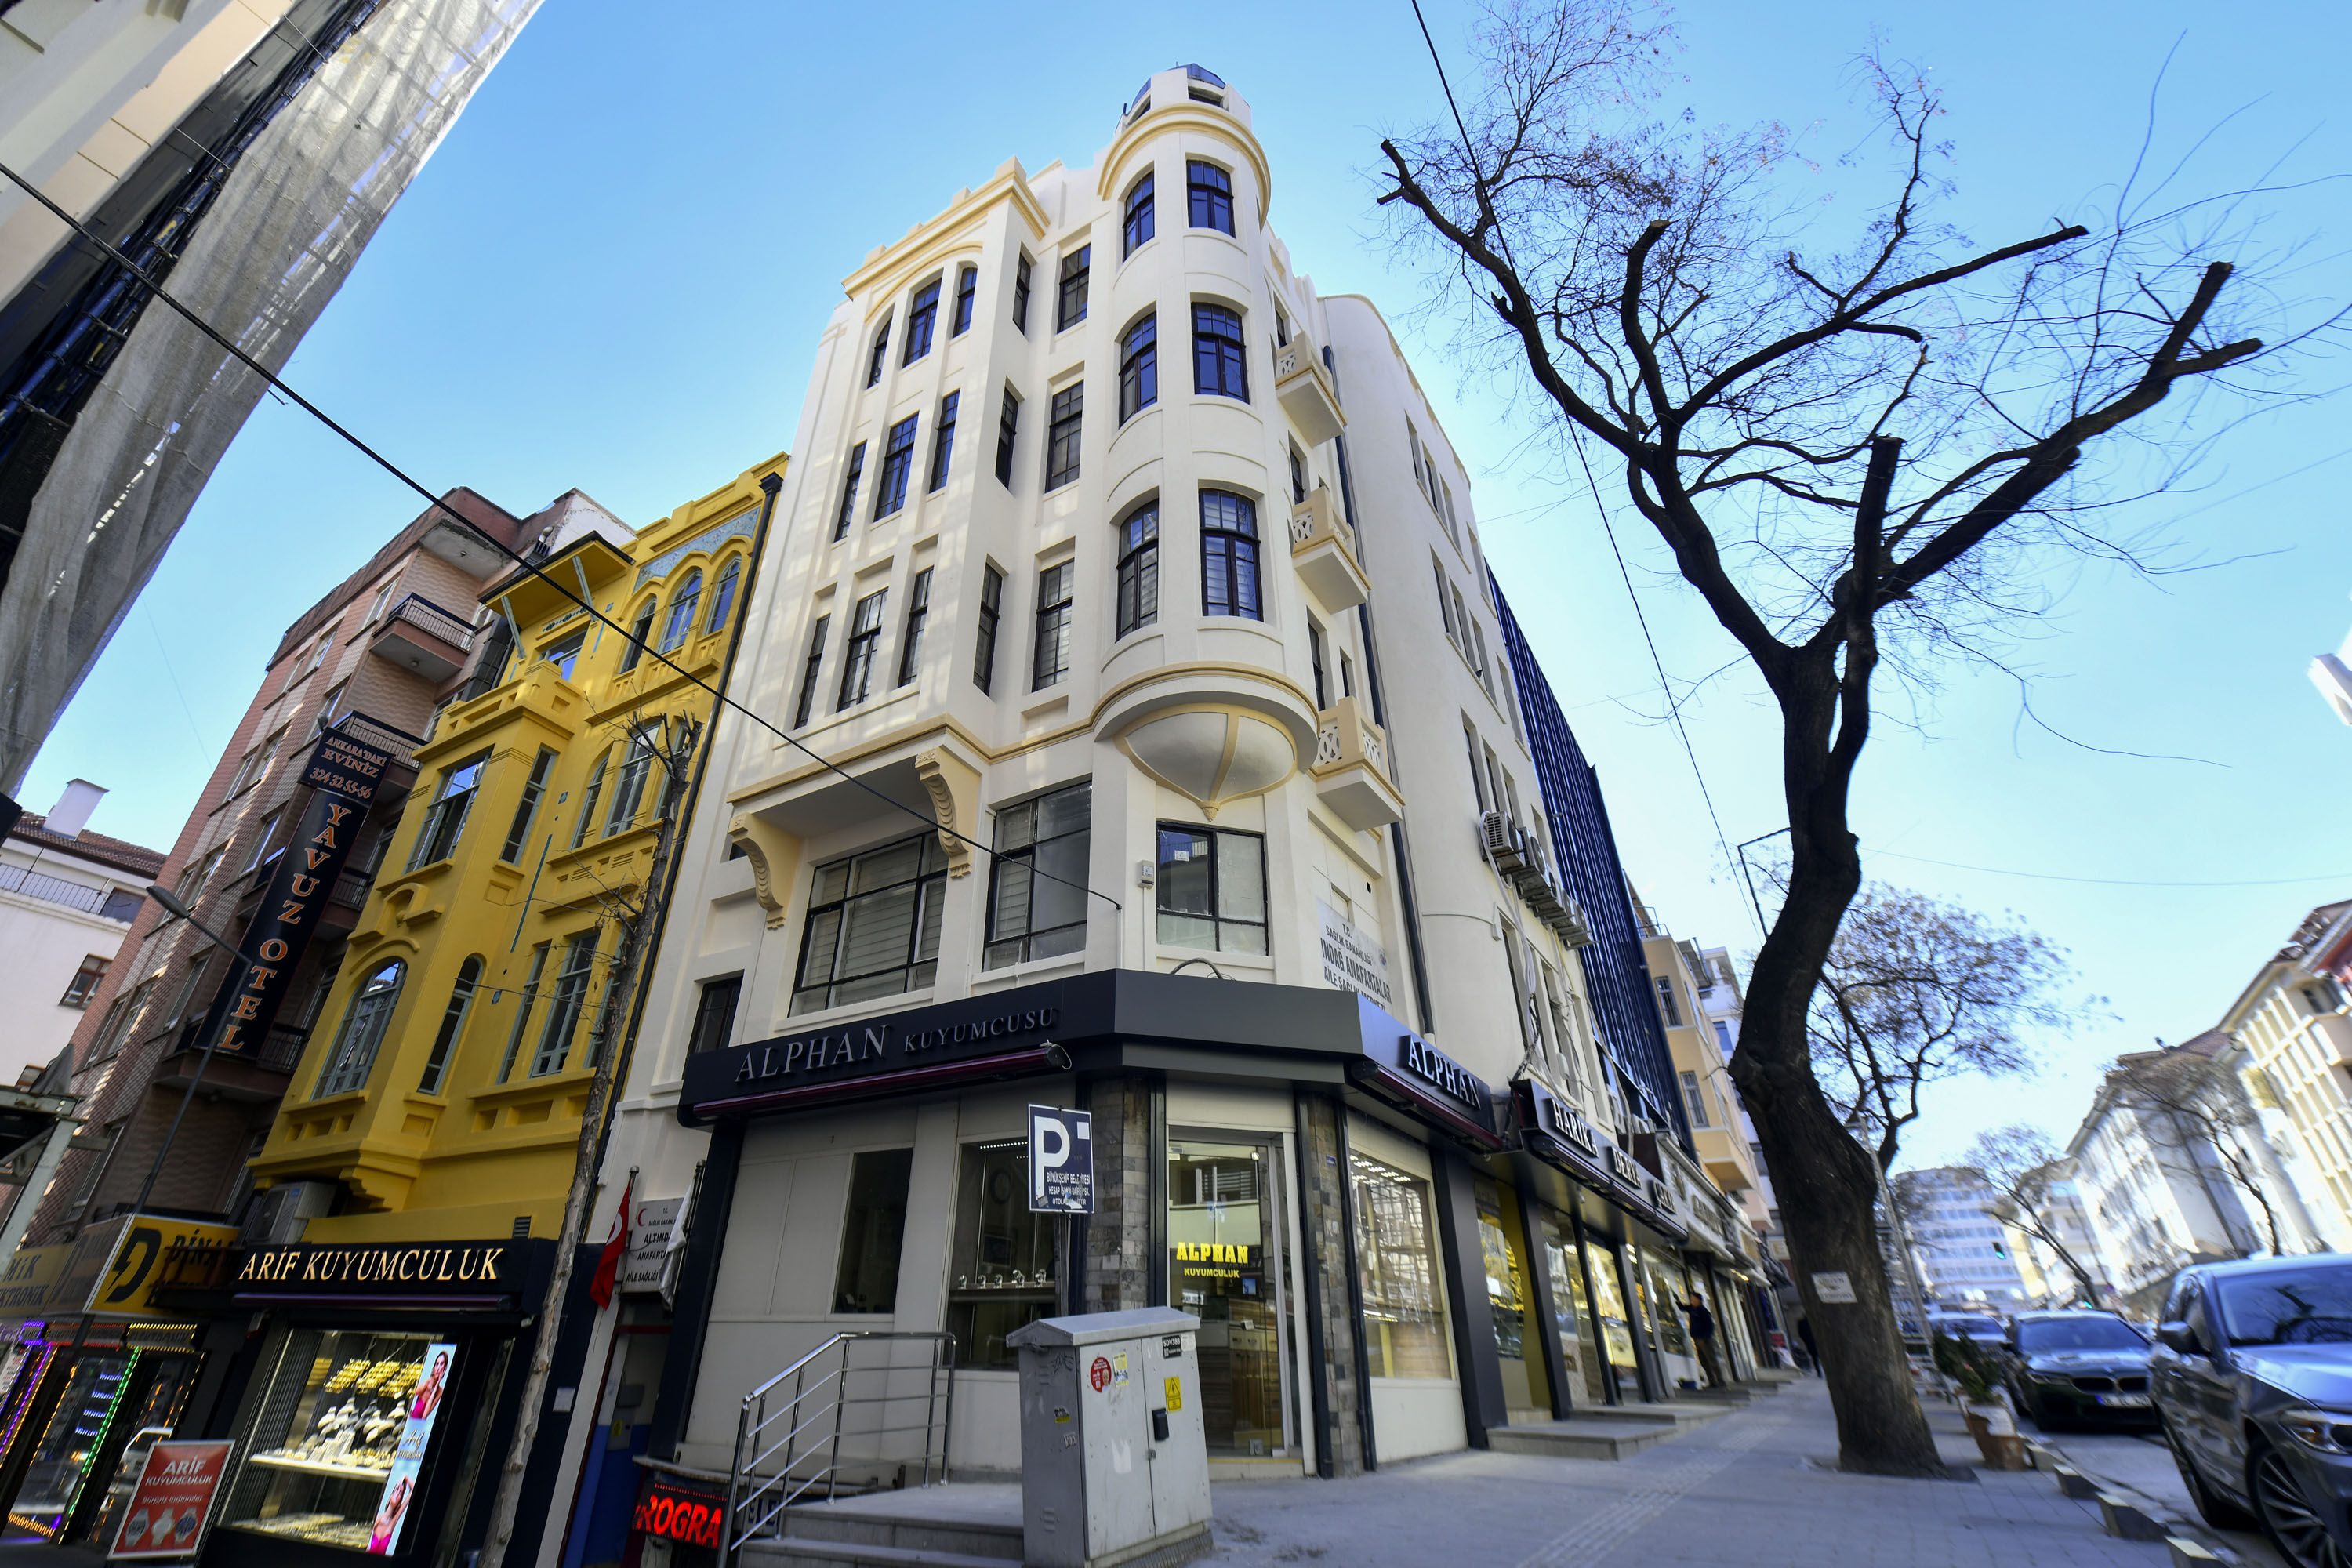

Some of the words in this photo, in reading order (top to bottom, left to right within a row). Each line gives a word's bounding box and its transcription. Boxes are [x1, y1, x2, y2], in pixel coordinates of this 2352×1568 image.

[321, 748, 379, 778] EVİNİZ
[310, 767, 331, 783] 324
[329, 774, 344, 789] 32
[343, 779, 373, 799] 55-56
[278, 802, 352, 925] YAVUZ
[1326, 924, 1345, 946] SAĞLIK
[1345, 939, 1373, 967] BAKANLIĞI
[1324, 965, 1338, 987] AİLE
[1345, 956, 1392, 1004] ANAFARTALAR
[216, 938, 289, 1051] OTEL
[735, 1024, 891, 1083] ALPHAN
[904, 1007, 1055, 1053] KUYUMCUSU
[1407, 1034, 1482, 1110] ALPHAN
[1034, 1115, 1071, 1200] P
[1048, 1185, 1061, 1195] HESAP
[238, 1246, 302, 1281] ARİF
[300, 1247, 504, 1281] KUYUMCULUK
[1176, 1241, 1249, 1264] ALPHAN
[626, 1272, 638, 1283] AİLE
[637, 1269, 659, 1282] SAĞLIĞI
[1184, 1267, 1240, 1278] KUYUMCULUK
[145, 1474, 214, 1486] KUYUMCULUK
[162, 1454, 207, 1475] ARİF
